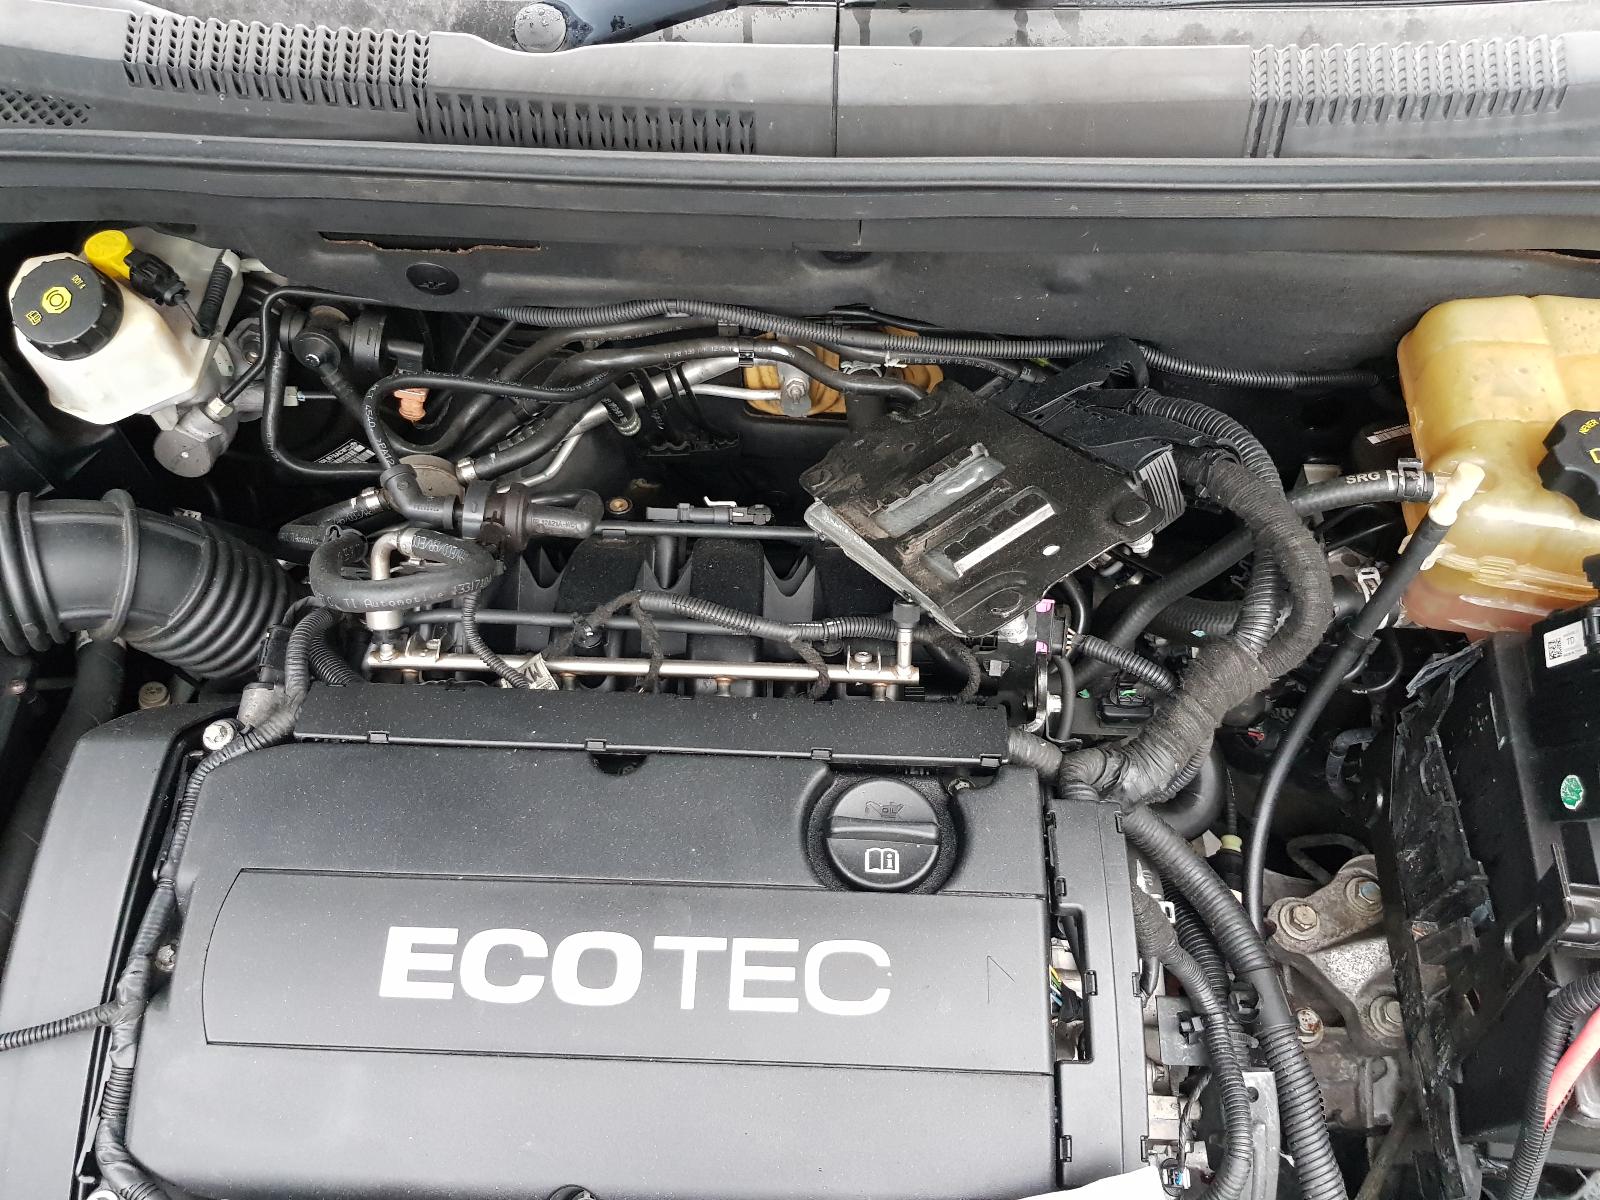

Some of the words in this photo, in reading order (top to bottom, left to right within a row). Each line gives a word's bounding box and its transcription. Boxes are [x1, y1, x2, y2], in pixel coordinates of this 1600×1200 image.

[1346, 472, 1381, 485] SRG
[881, 806, 898, 814] OIL
[379, 925, 892, 1017] ECOTEC
